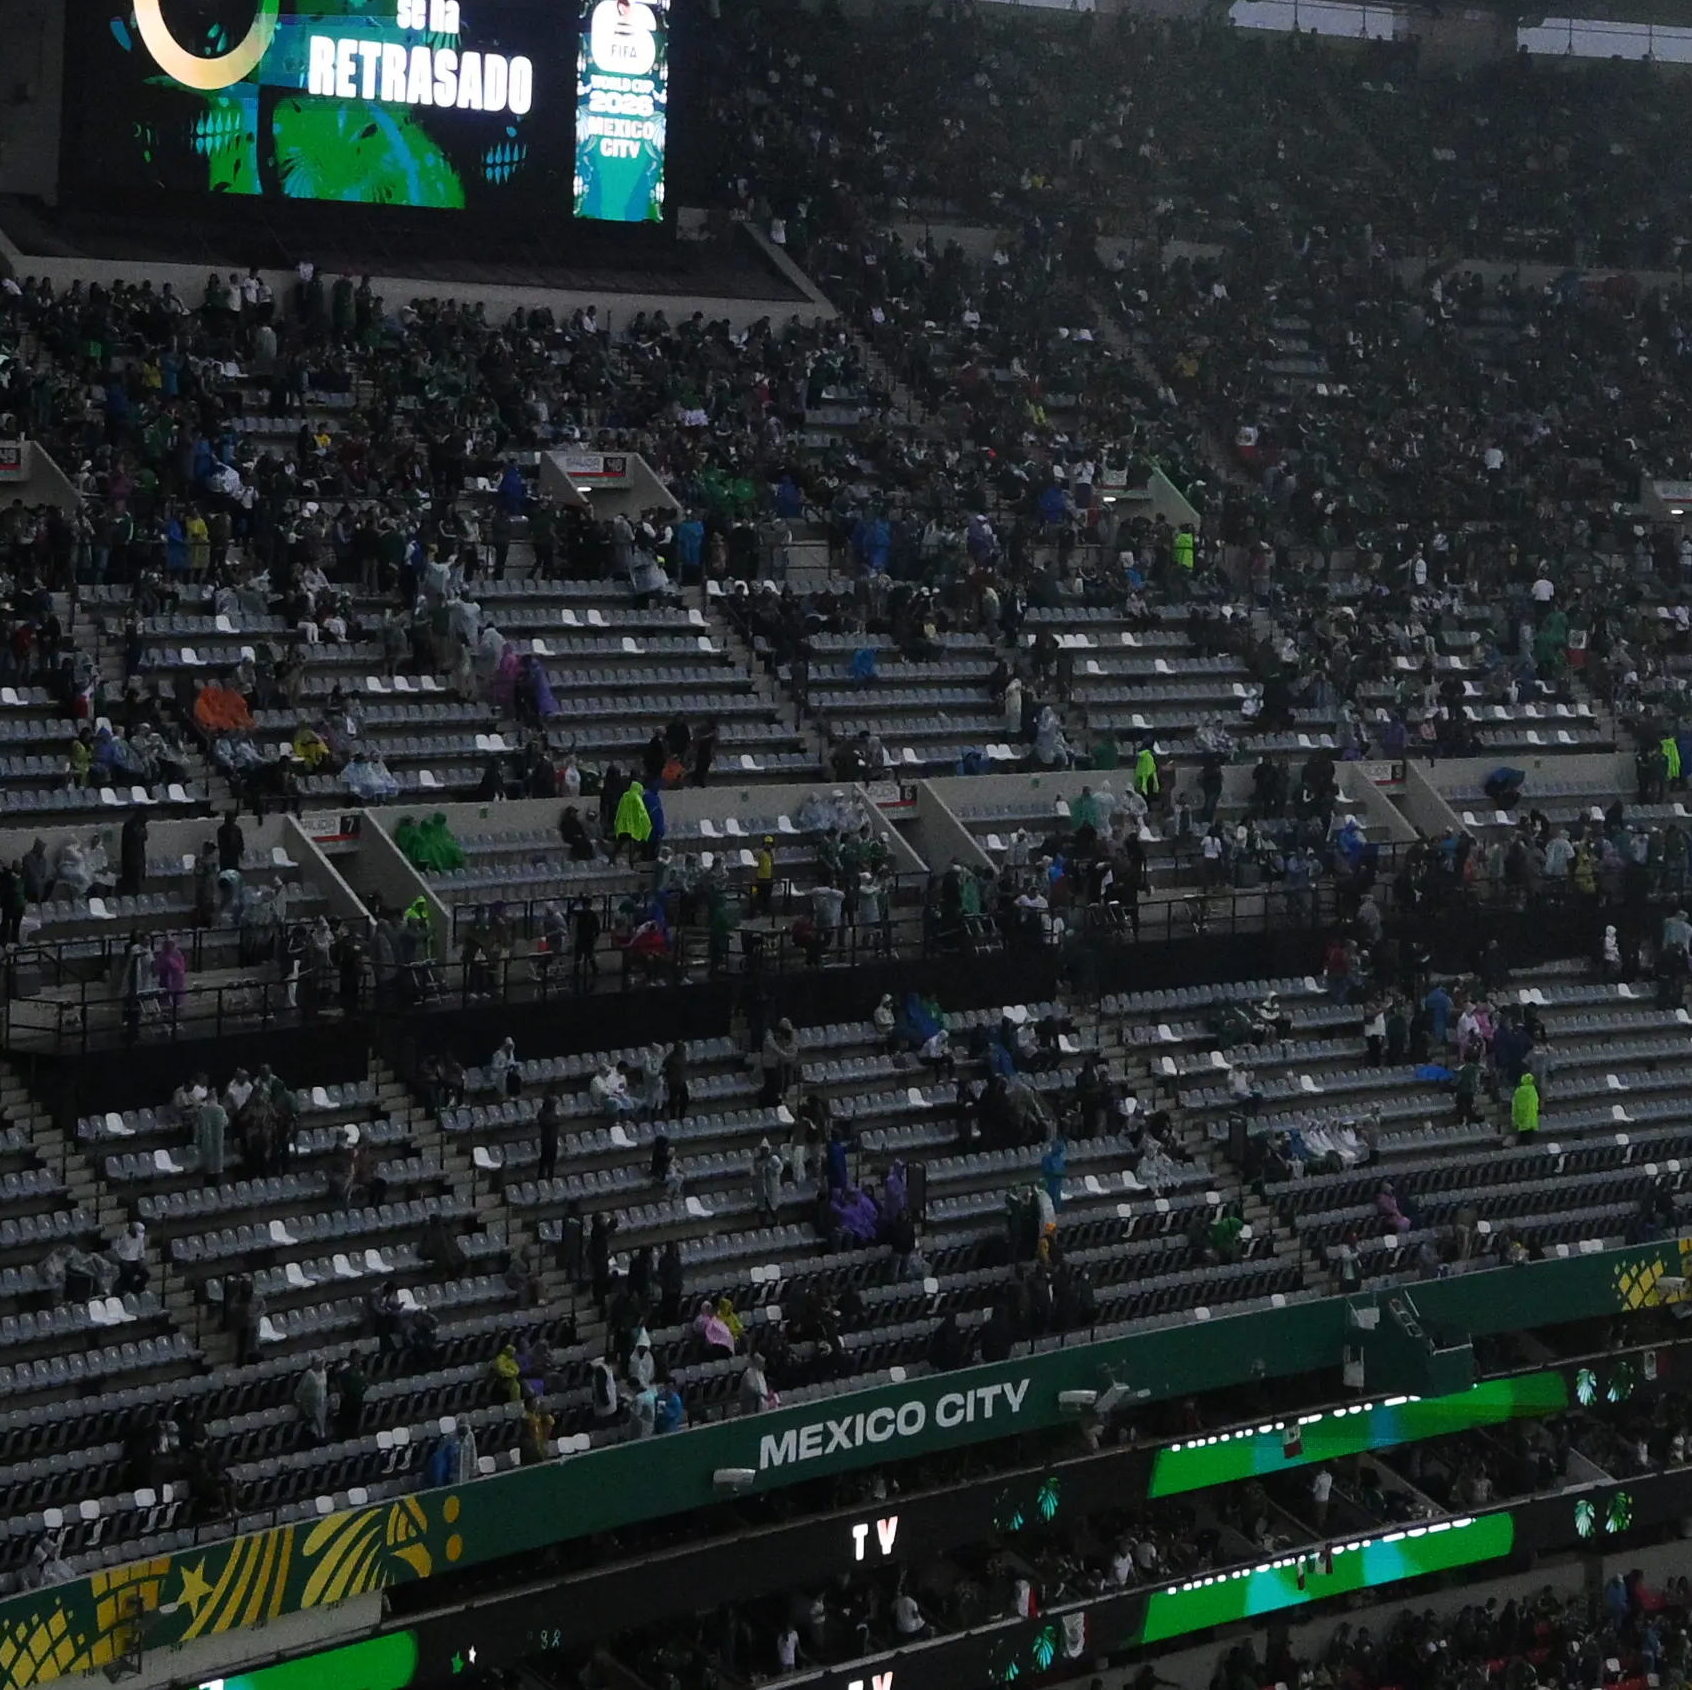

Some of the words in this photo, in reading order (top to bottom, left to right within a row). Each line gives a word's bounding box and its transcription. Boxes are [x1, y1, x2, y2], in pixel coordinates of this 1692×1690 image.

[611, 44, 637, 59] FIFA
[308, 35, 534, 115] RETRASADO
[590, 74, 631, 92] WORLD
[631, 78, 655, 94] CUP
[589, 90, 655, 117] 2026
[588, 115, 655, 140] MEXICO
[600, 138, 642, 158] CITY
[759, 1400, 927, 1471] MEXICO
[936, 1378, 1032, 1430] CITY
